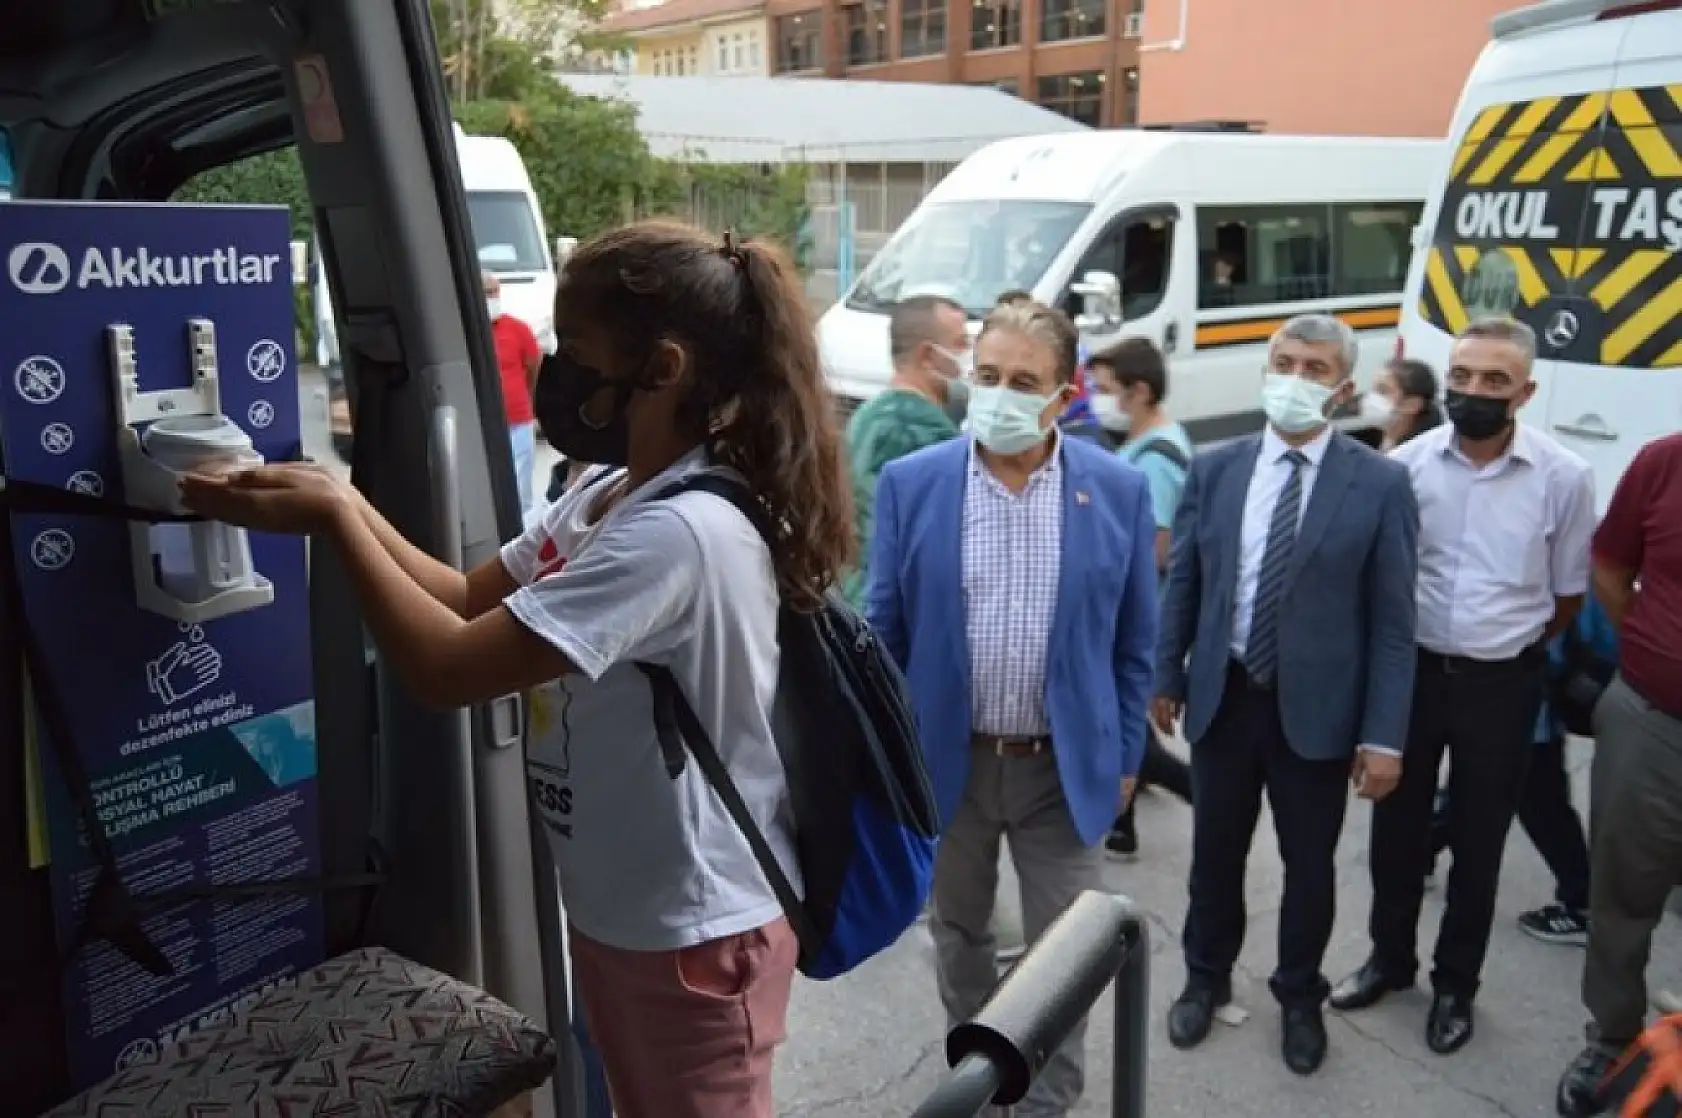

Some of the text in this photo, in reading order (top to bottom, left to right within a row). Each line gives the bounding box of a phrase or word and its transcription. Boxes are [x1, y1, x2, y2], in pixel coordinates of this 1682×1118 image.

[1456, 186, 1682, 253] OKUL TAŞ
[77, 245, 280, 290] Akkurtlar
[137, 709, 191, 732] Lütfen
[92, 763, 184, 808] ONTROLLÜ
